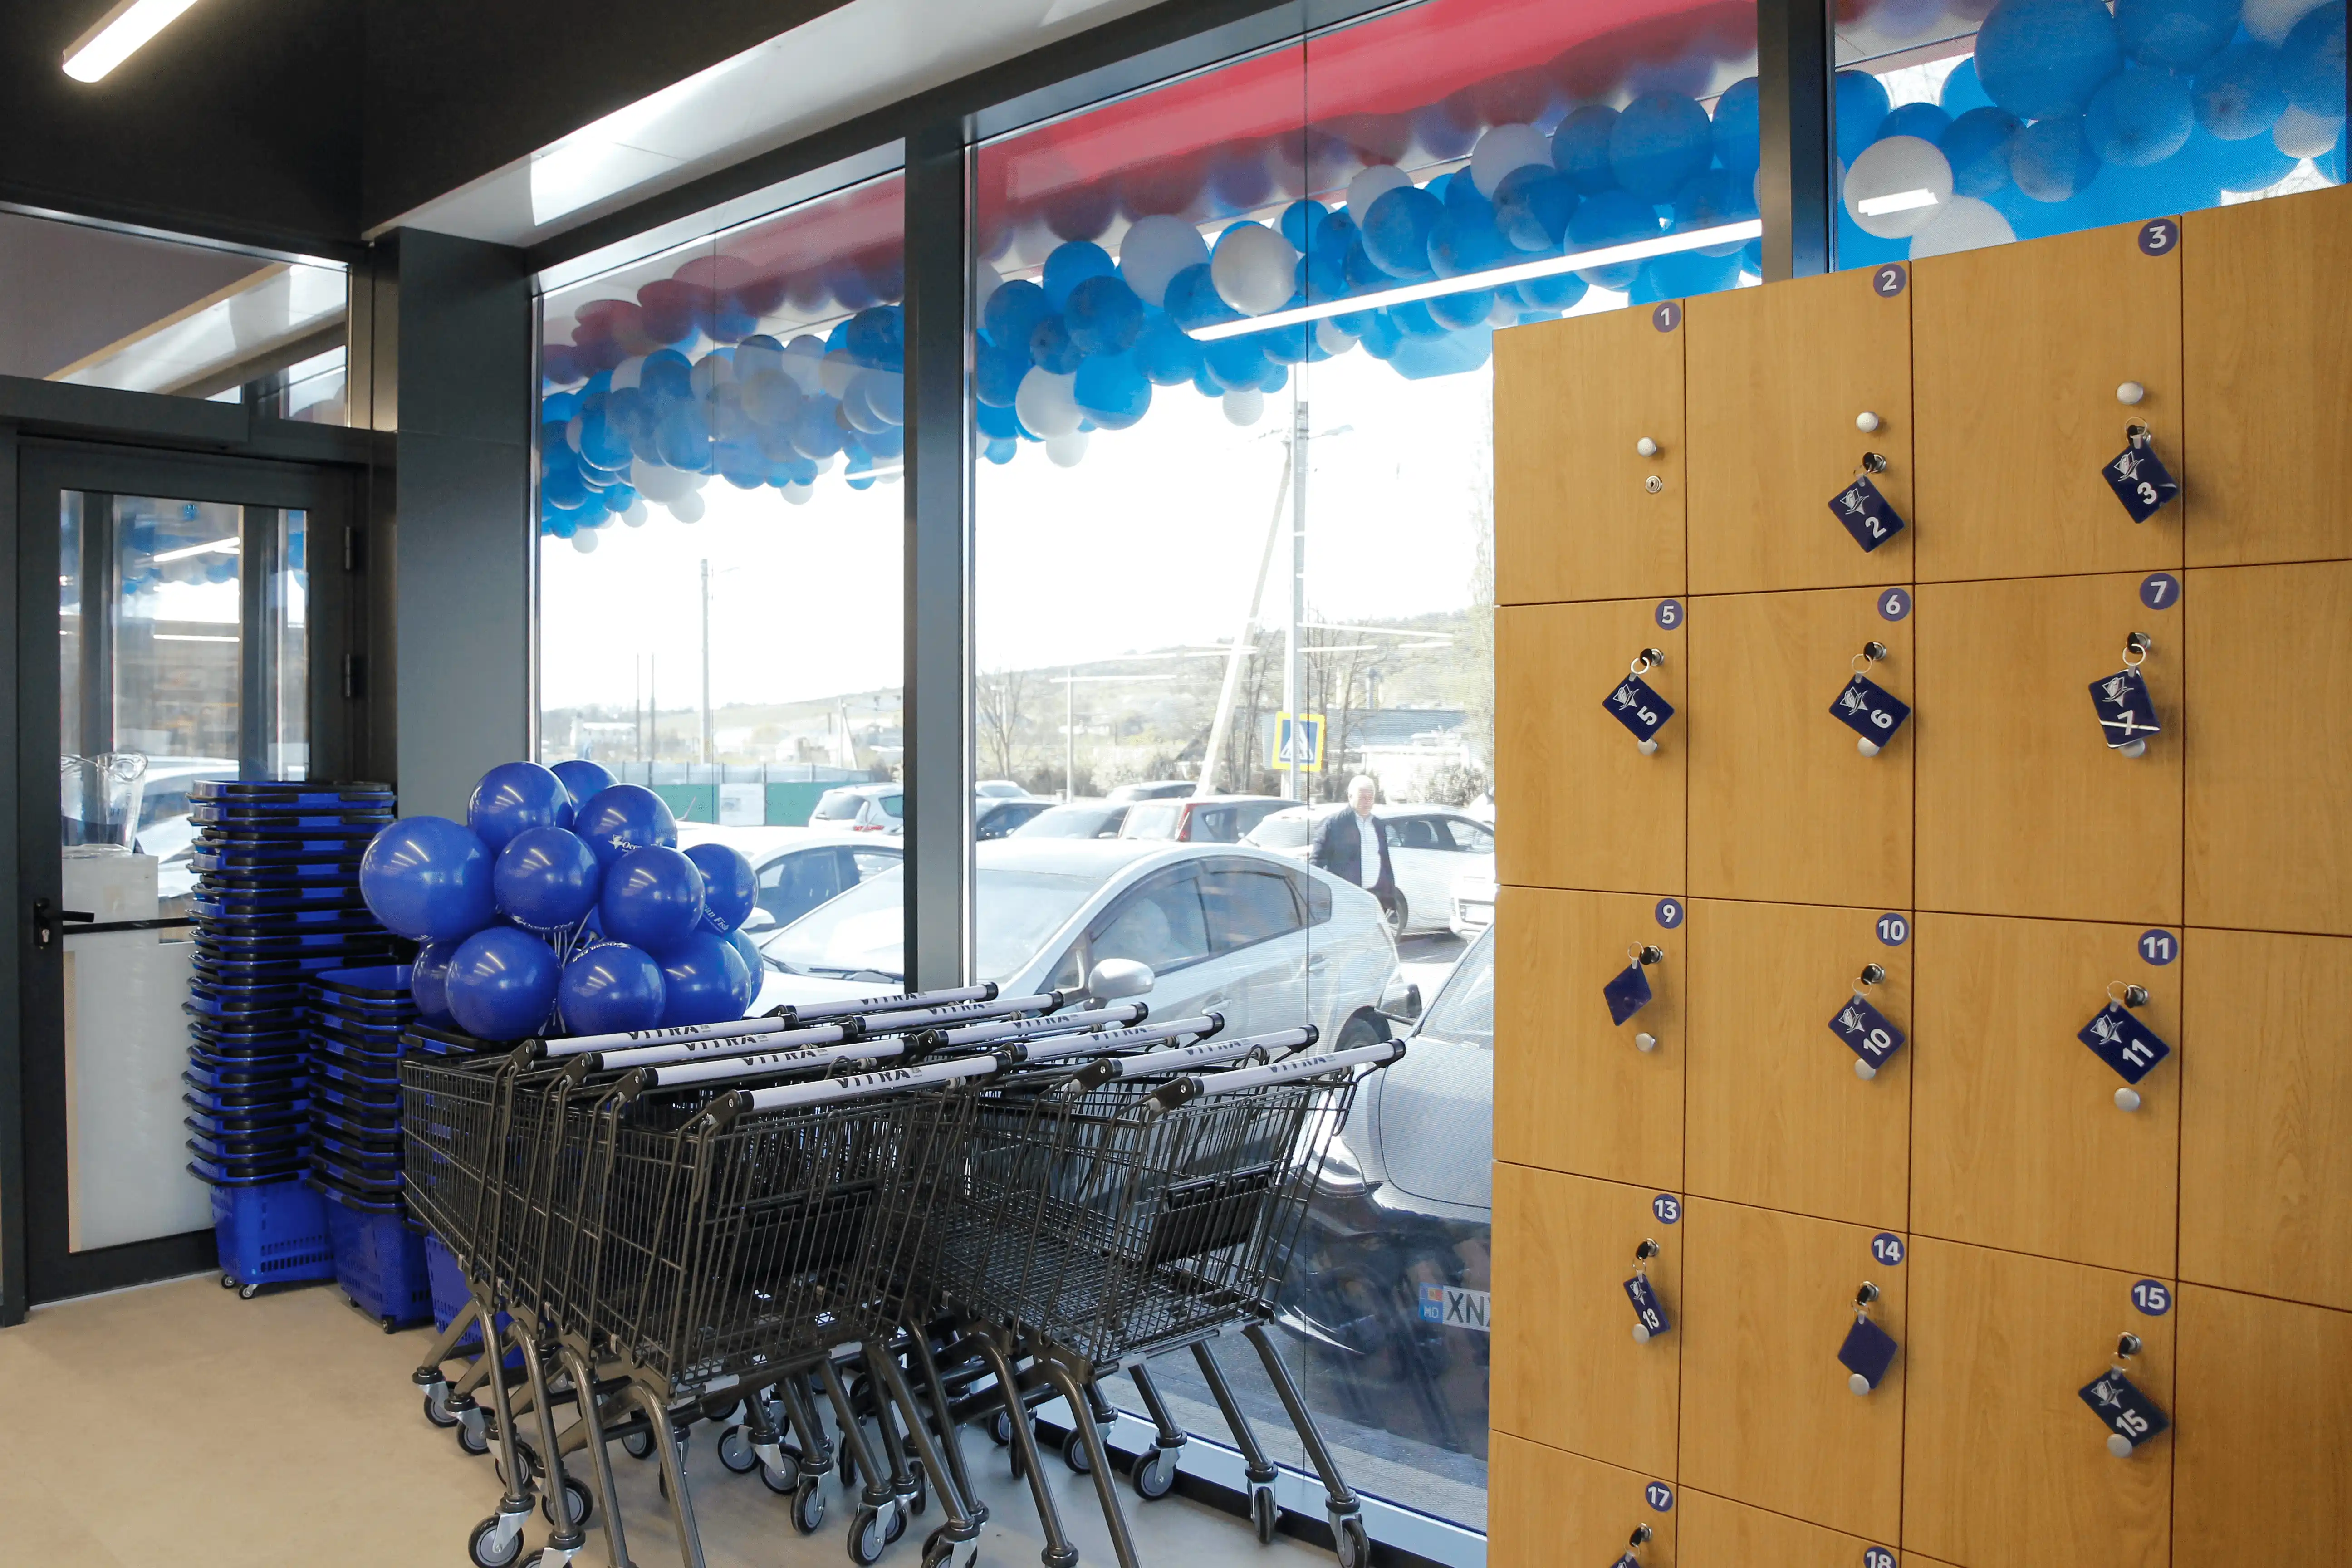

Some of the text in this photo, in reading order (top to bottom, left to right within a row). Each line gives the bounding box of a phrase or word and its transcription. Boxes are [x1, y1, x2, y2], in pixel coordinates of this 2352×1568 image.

[2148, 225, 2167, 249] 3
[1882, 270, 1897, 292] 2
[1660, 307, 1670, 326] 1
[2136, 482, 2157, 505] 3
[1865, 516, 1887, 539] 2
[2150, 580, 2167, 603] 7
[1661, 605, 1675, 624] 5
[1885, 594, 1901, 615] 6
[1637, 706, 1657, 725] 5
[1870, 709, 1892, 729] 6
[2117, 709, 2134, 736] 7
[1662, 904, 1676, 923] 9
[1878, 919, 1905, 941] 10
[2143, 936, 2170, 960] 11
[627, 1026, 699, 1040] VITRA
[684, 1036, 757, 1051] VITRA
[1863, 1028, 1891, 1055] 10
[742, 1050, 817, 1066] VITRA
[2122, 1038, 2154, 1067] 11
[836, 1069, 911, 1088] VITRA
[1654, 1199, 1677, 1220] 13
[1873, 1238, 1901, 1262] 14
[2134, 1285, 2166, 1310] 15
[1424, 1304, 1439, 1318] MD
[1446, 1291, 1490, 1327] XN
[1642, 1308, 1660, 1330] 13
[2116, 1408, 2149, 1437] 15
[1647, 1486, 1670, 1507] 17
[1866, 1550, 1892, 1568] 18
